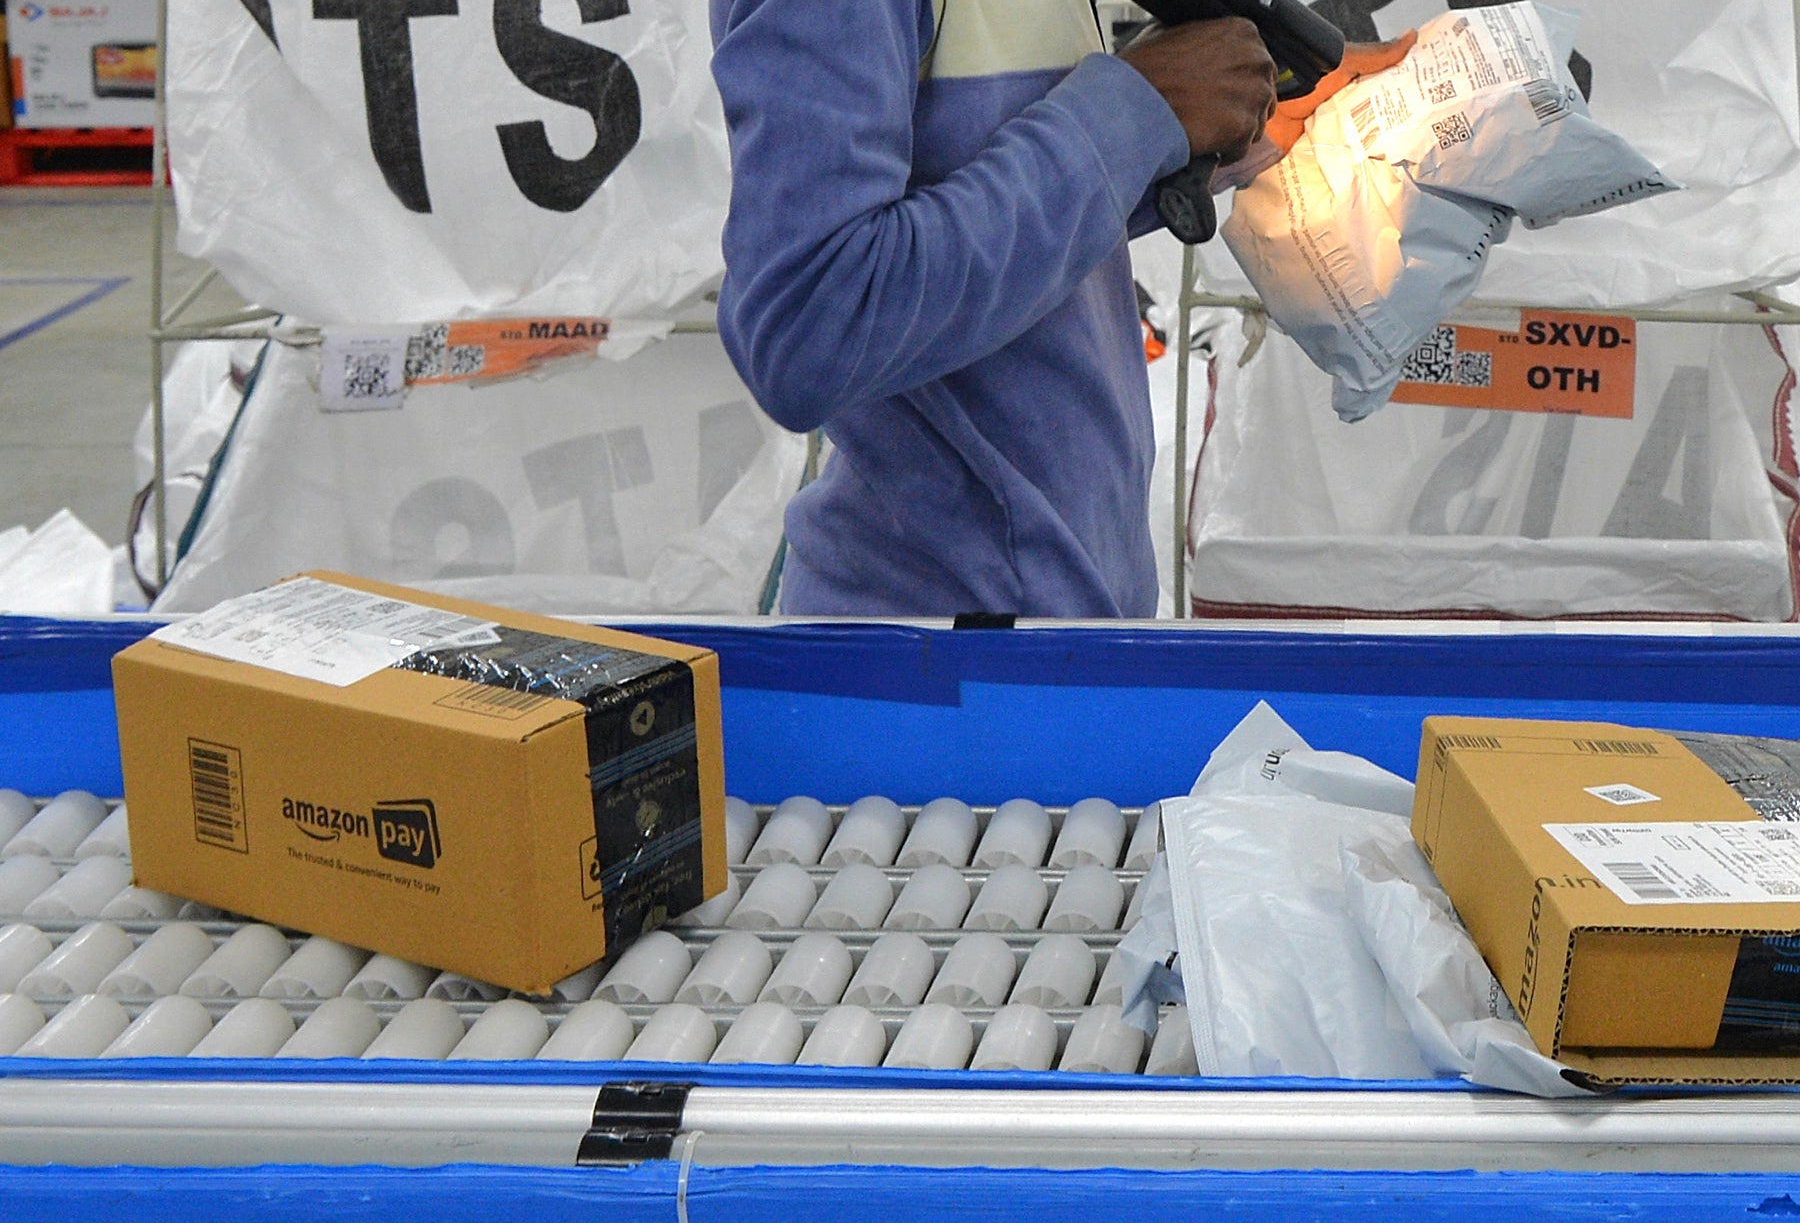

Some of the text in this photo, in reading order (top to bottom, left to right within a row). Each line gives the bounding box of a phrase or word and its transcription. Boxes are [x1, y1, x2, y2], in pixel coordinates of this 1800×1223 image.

[1525, 321, 1631, 349] SXVD-
[1527, 366, 1600, 393] OTH
[282, 796, 427, 856] amazon pay
[287, 847, 441, 896] The trusted & convenient way to pay
